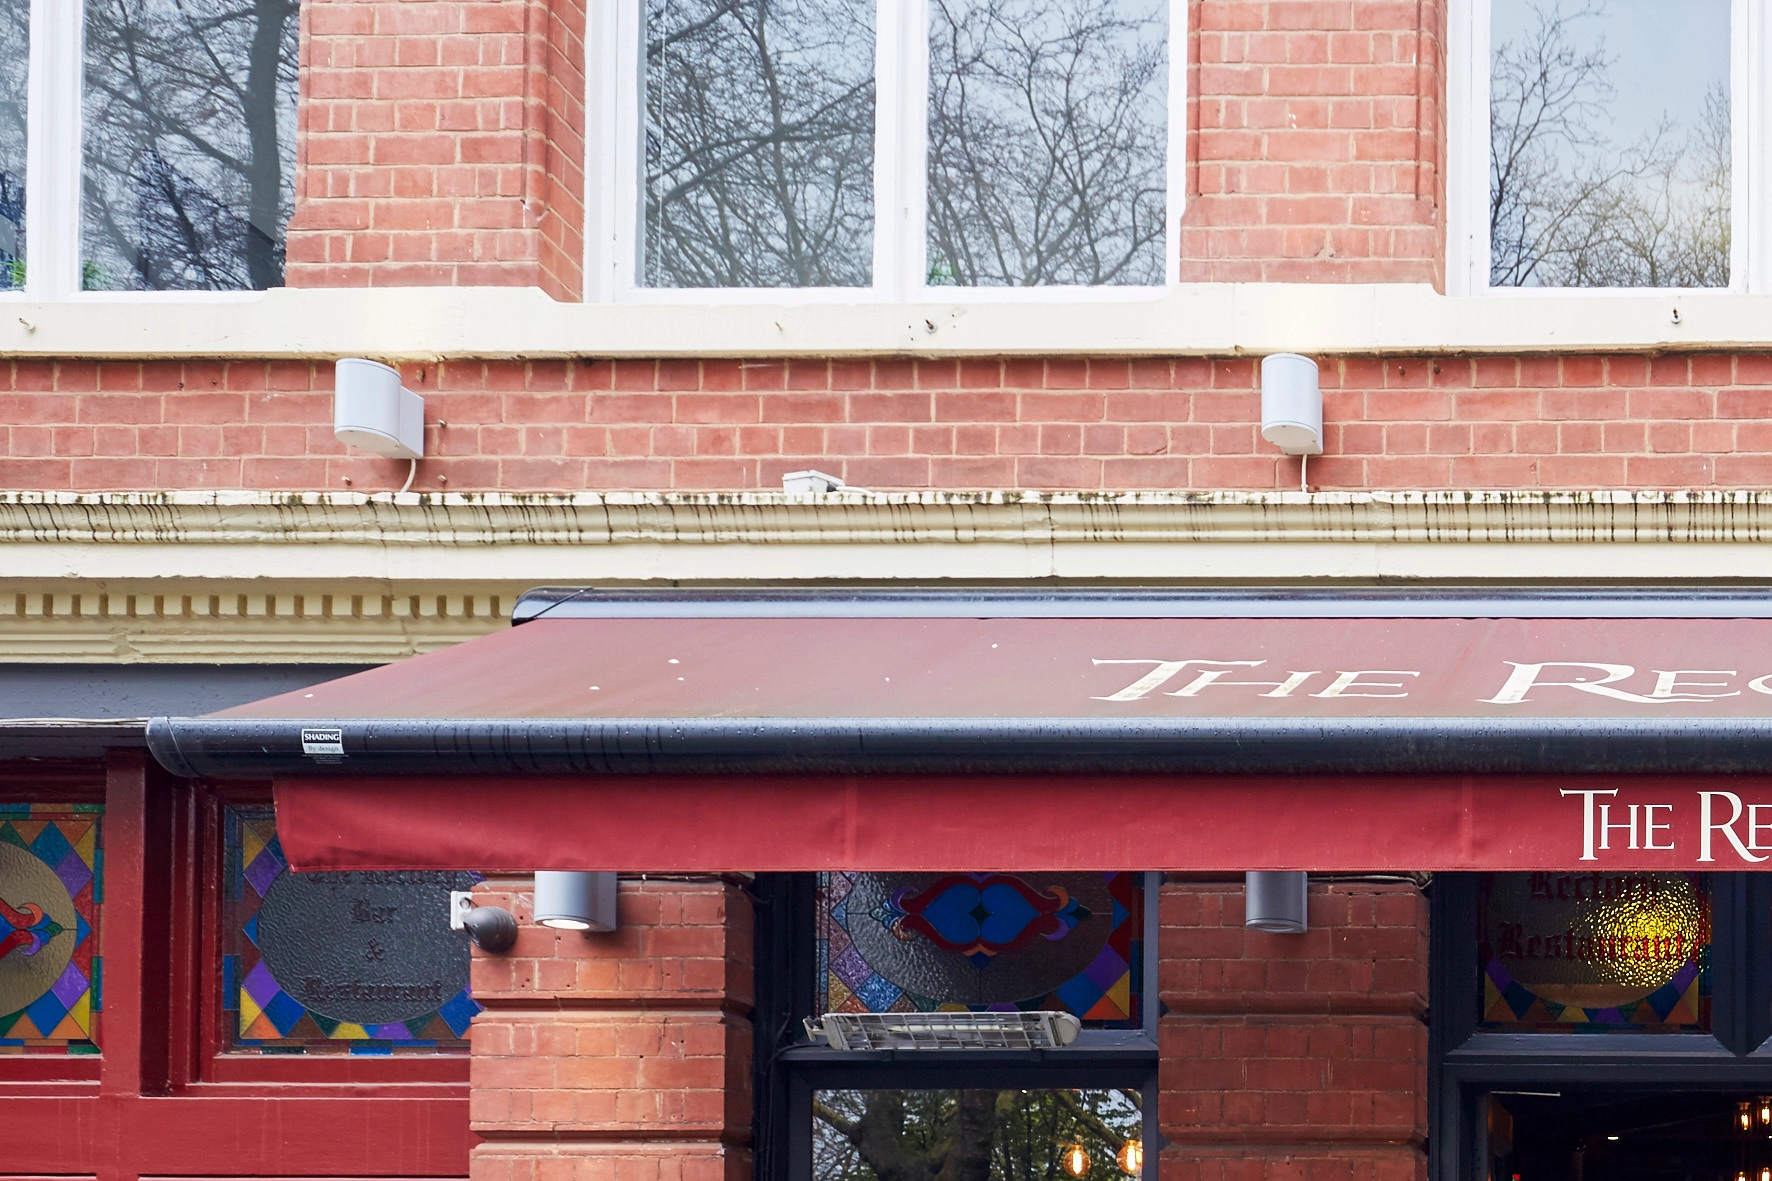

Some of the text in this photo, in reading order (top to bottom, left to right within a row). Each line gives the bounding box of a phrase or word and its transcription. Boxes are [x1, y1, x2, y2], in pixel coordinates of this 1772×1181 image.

[1089, 658, 1421, 701] THE
[304, 733, 340, 741] SHADING
[1559, 787, 1676, 861] THE
[1498, 922, 1684, 960] Restaurant
